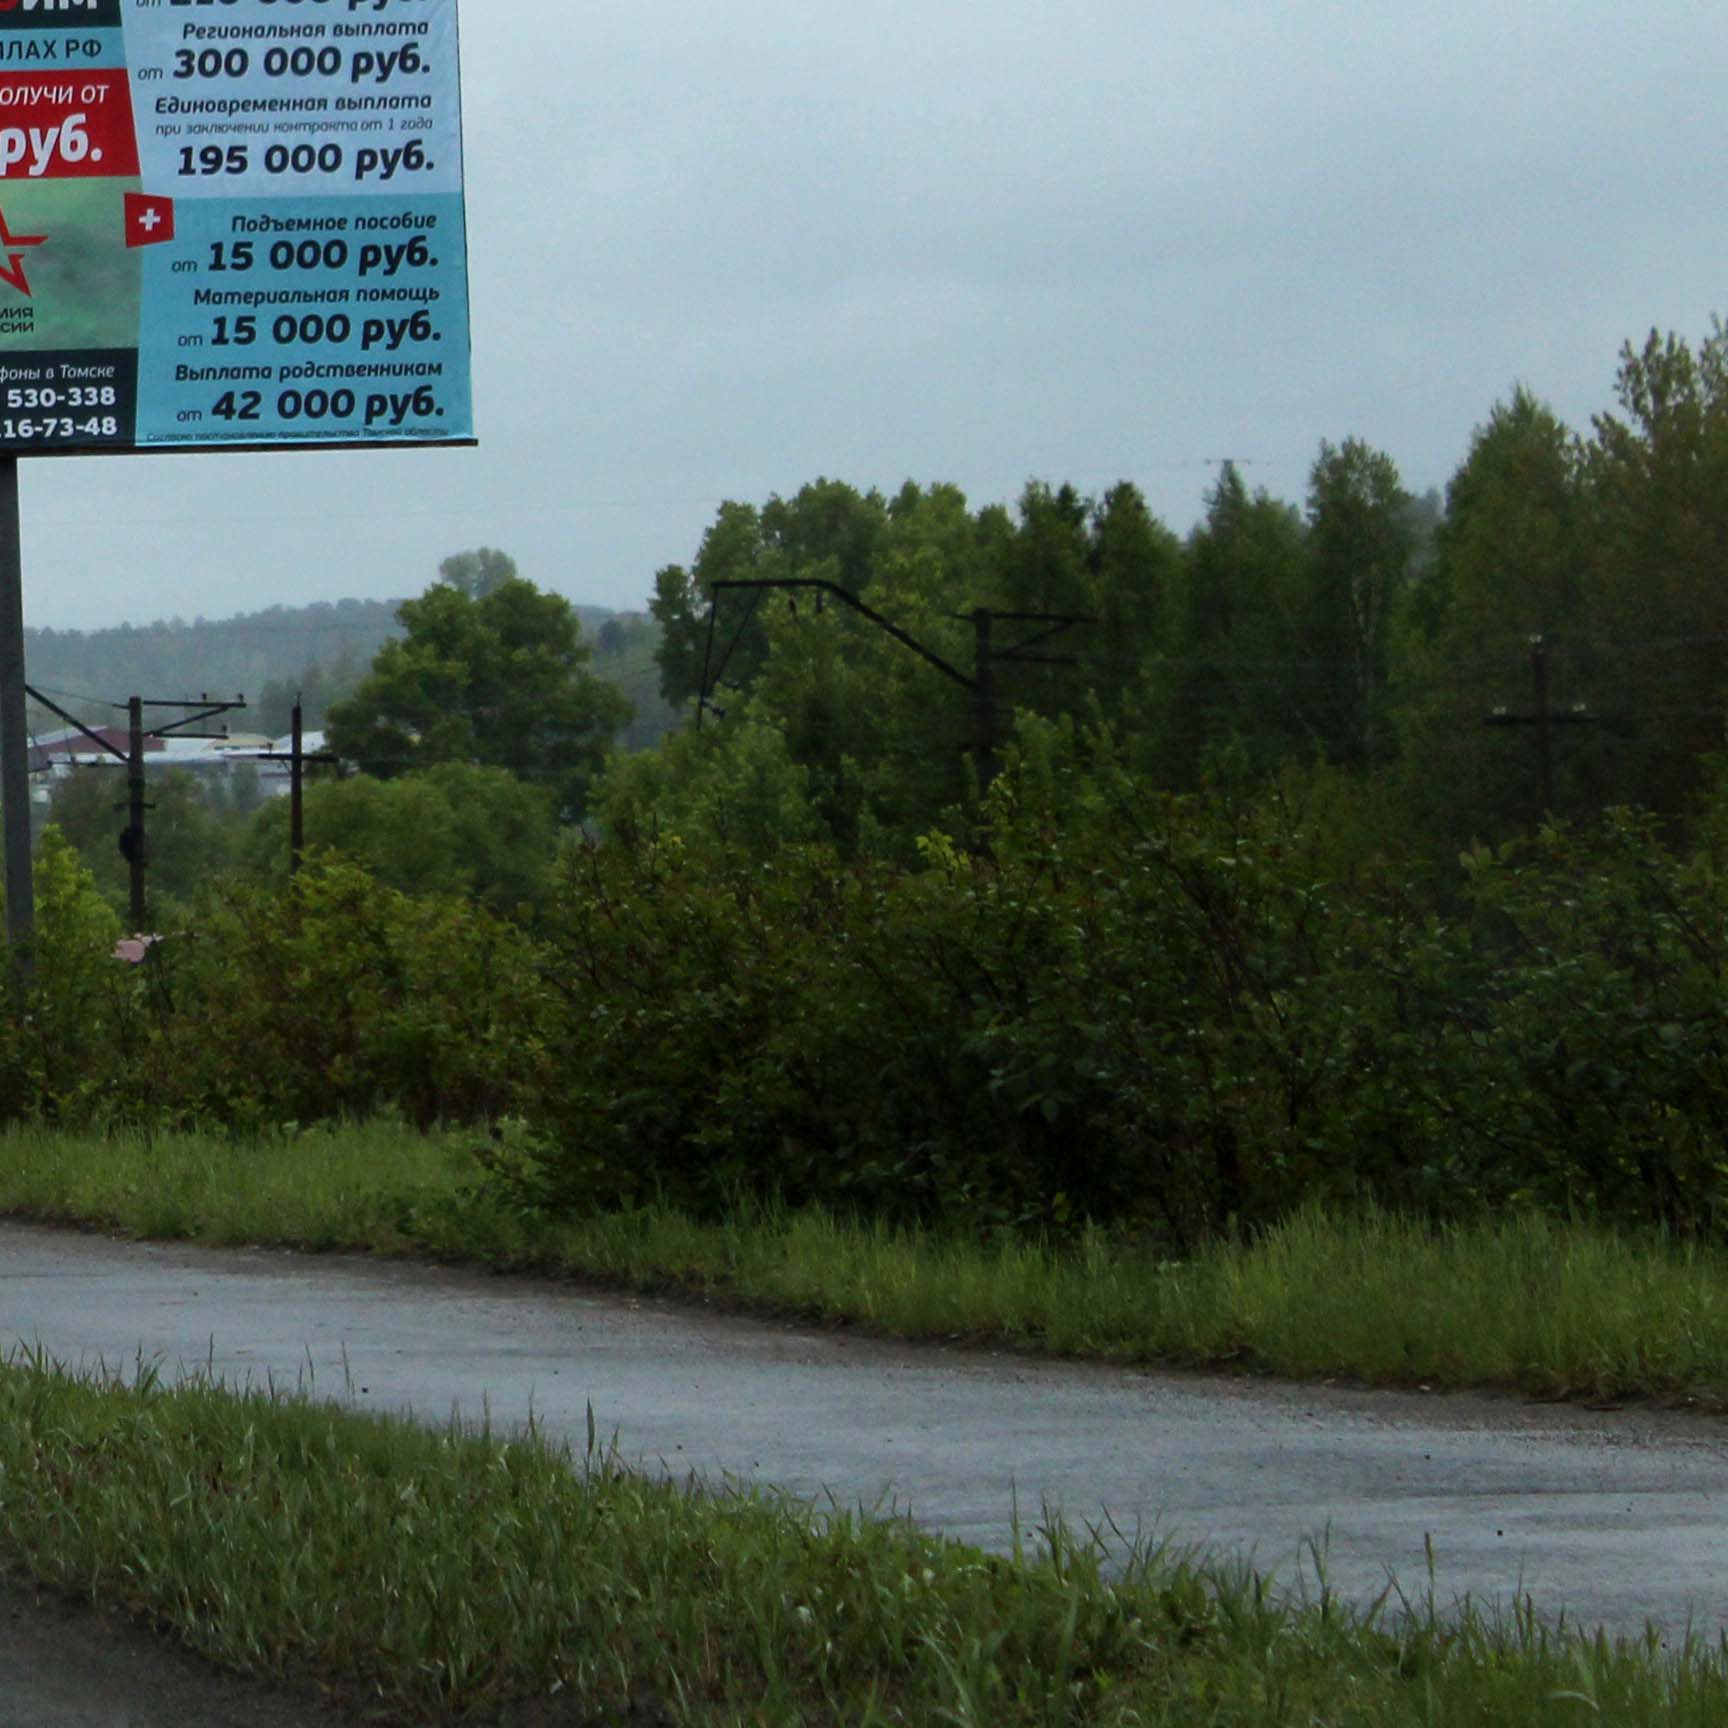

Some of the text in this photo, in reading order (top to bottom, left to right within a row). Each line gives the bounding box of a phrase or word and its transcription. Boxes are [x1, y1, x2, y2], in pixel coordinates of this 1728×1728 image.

[182, 20, 429, 42] Региональная выплата
[64, 37, 102, 60] РФ
[138, 43, 430, 82] от 300 000 руб.
[80, 84, 110, 104] ОТ
[154, 94, 432, 116] Единовременная выплата
[155, 124, 179, 137] при
[186, 122, 270, 135] заключении
[360, 118, 383, 132] от
[388, 118, 395, 130] 1
[400, 116, 433, 132] года
[178, 140, 434, 179] 195 000 руб.
[232, 212, 437, 234] Подъемное пособие
[172, 236, 438, 275] от 15 000 руб.
[194, 286, 440, 308] Материальная помощь
[178, 310, 441, 350] от 15 000 руб.
[45, 367, 55, 378] в
[60, 363, 115, 380] Томске
[175, 361, 442, 382] Выплата родственникам
[6, 386, 116, 408] 530-338
[177, 386, 444, 424] от 42 000 руб.
